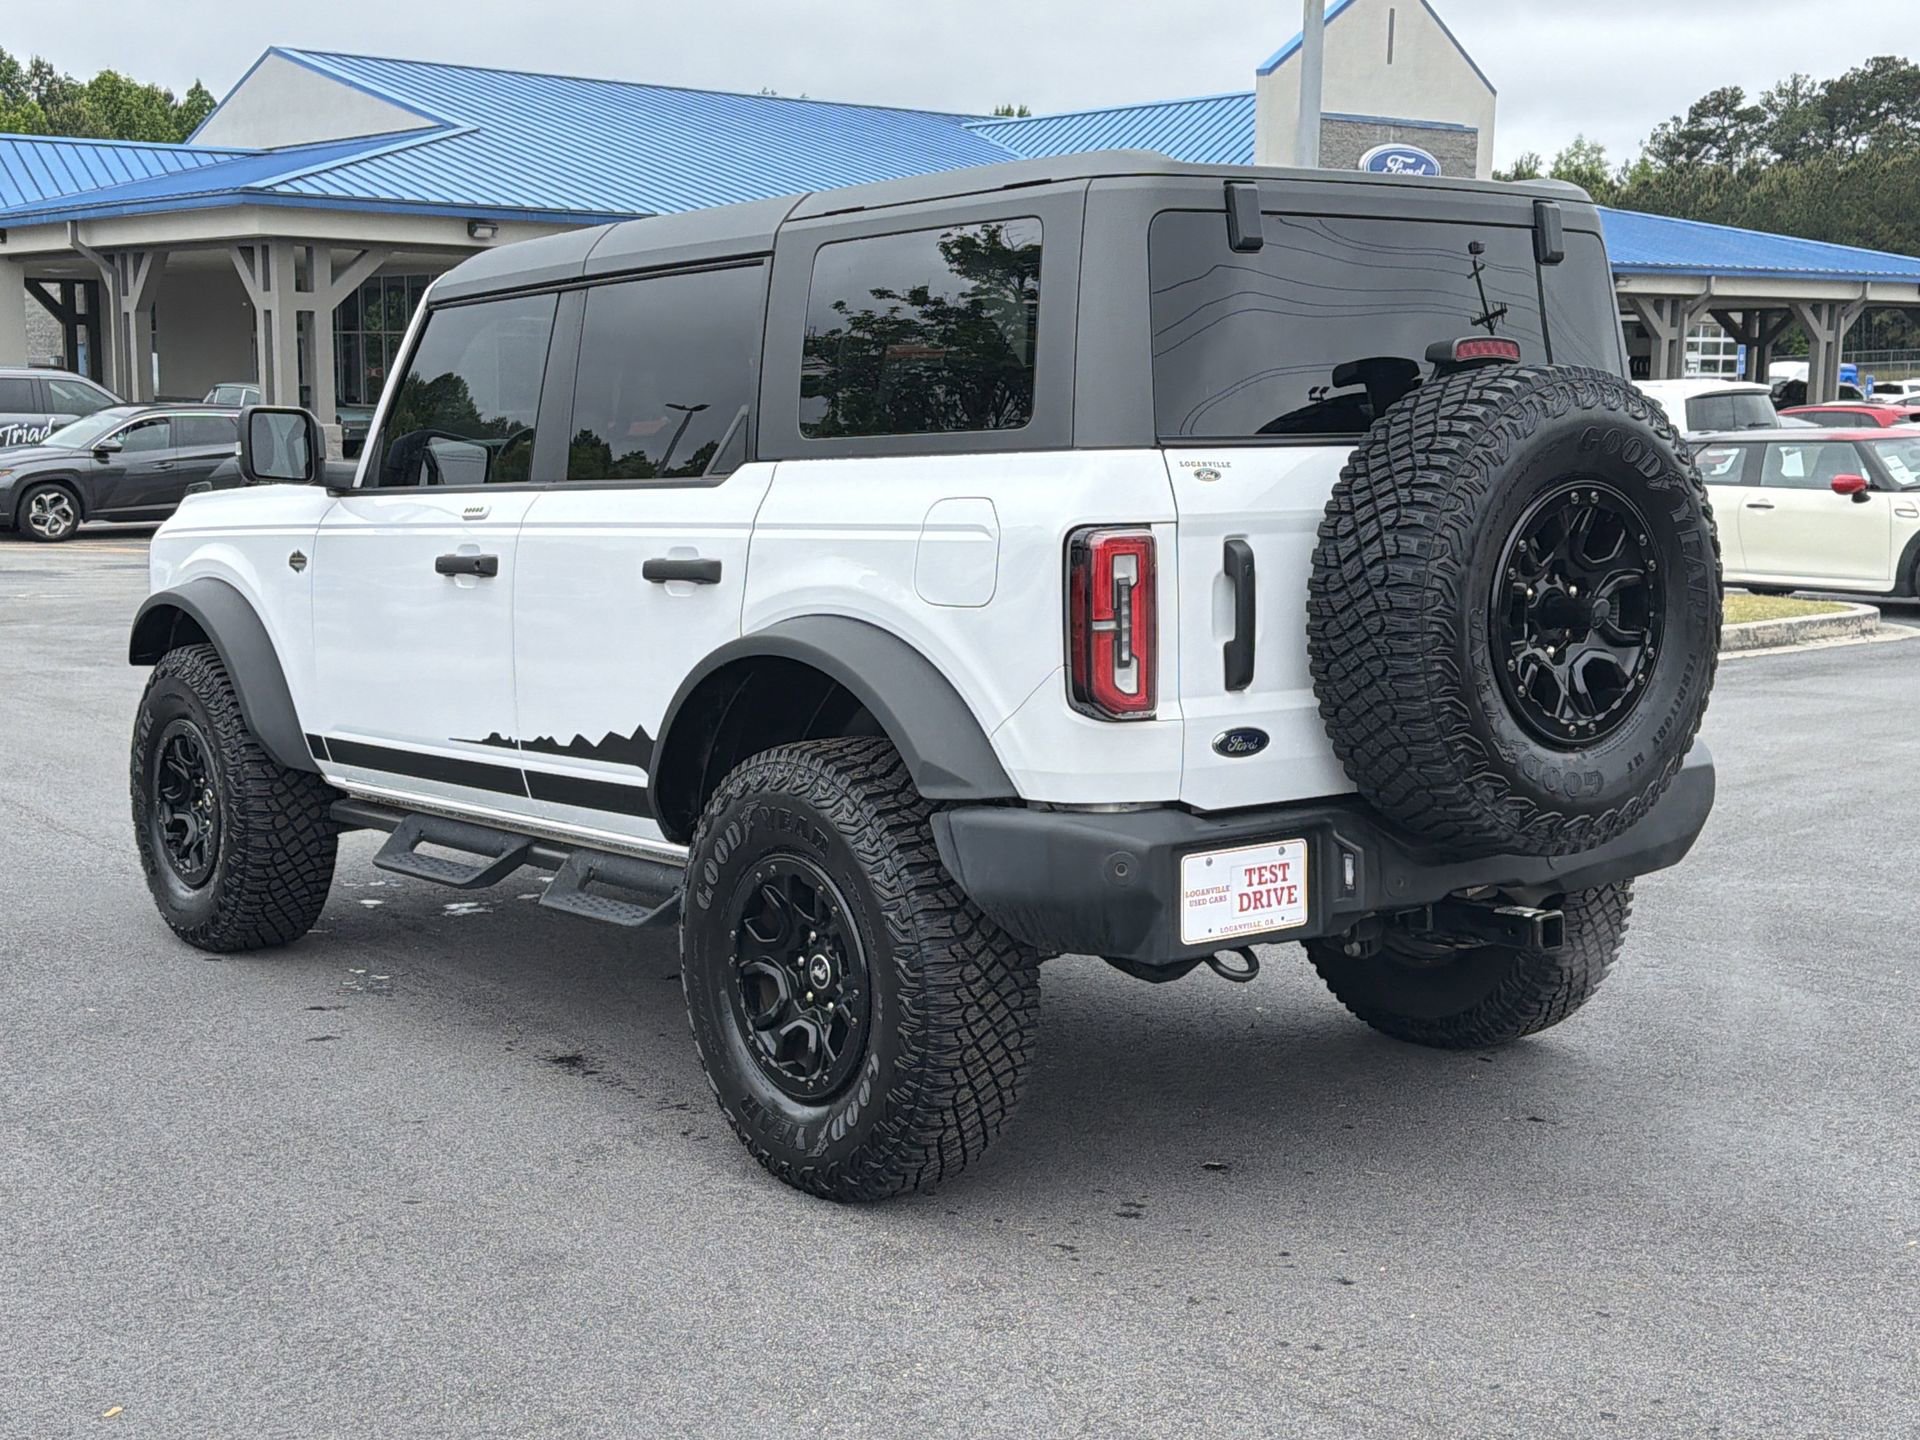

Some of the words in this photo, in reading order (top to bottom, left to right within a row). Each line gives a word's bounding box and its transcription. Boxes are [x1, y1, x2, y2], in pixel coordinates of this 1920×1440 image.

[0, 417, 56, 447] Triad
[1227, 735, 1259, 752] Ford
[1244, 863, 1290, 887] TEST
[1185, 885, 1231, 898] LOGANVILLE
[1238, 885, 1298, 912] DRIVE
[1189, 896, 1208, 907] USED
[1209, 894, 1228, 905] CARS
[1265, 918, 1275, 926] GA
